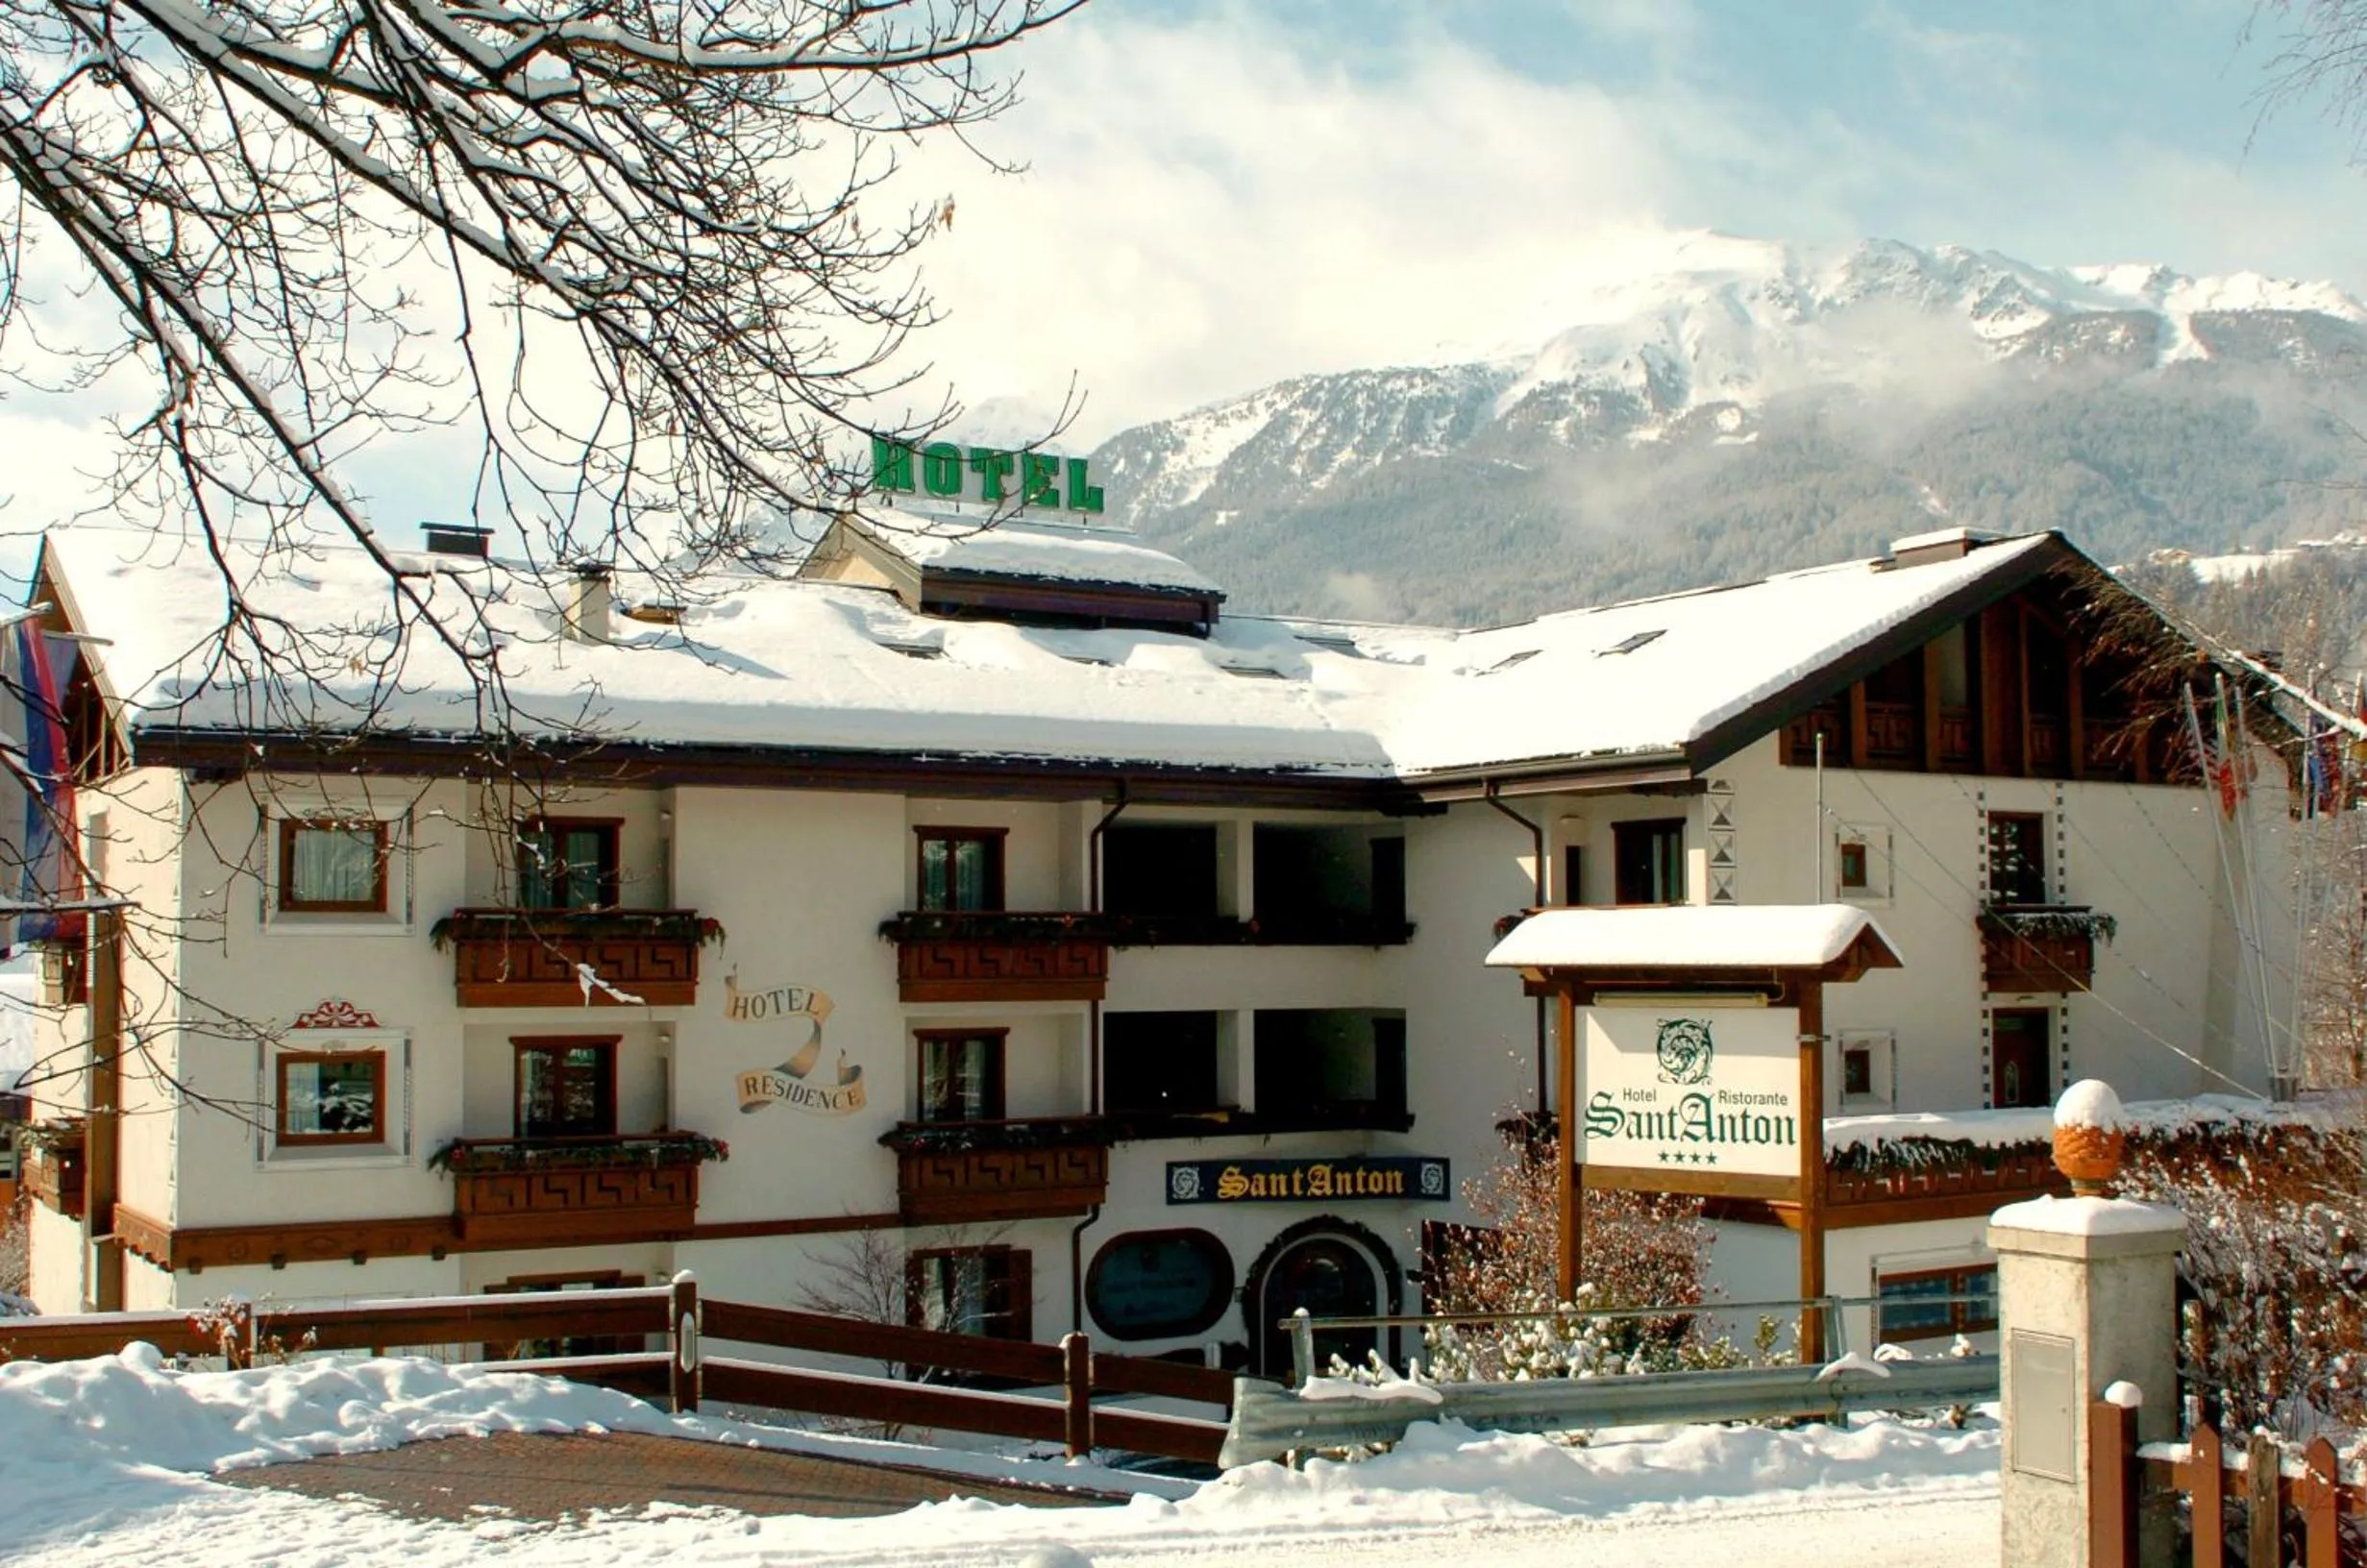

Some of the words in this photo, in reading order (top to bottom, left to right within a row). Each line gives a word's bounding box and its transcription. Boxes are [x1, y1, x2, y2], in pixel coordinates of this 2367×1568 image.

[872, 435, 1104, 513] HOTEL
[731, 988, 820, 1019] HOTEL
[744, 1075, 861, 1110] RESIDENCE
[1623, 1088, 1657, 1102] Hotel
[1718, 1090, 1788, 1106] Ristorante
